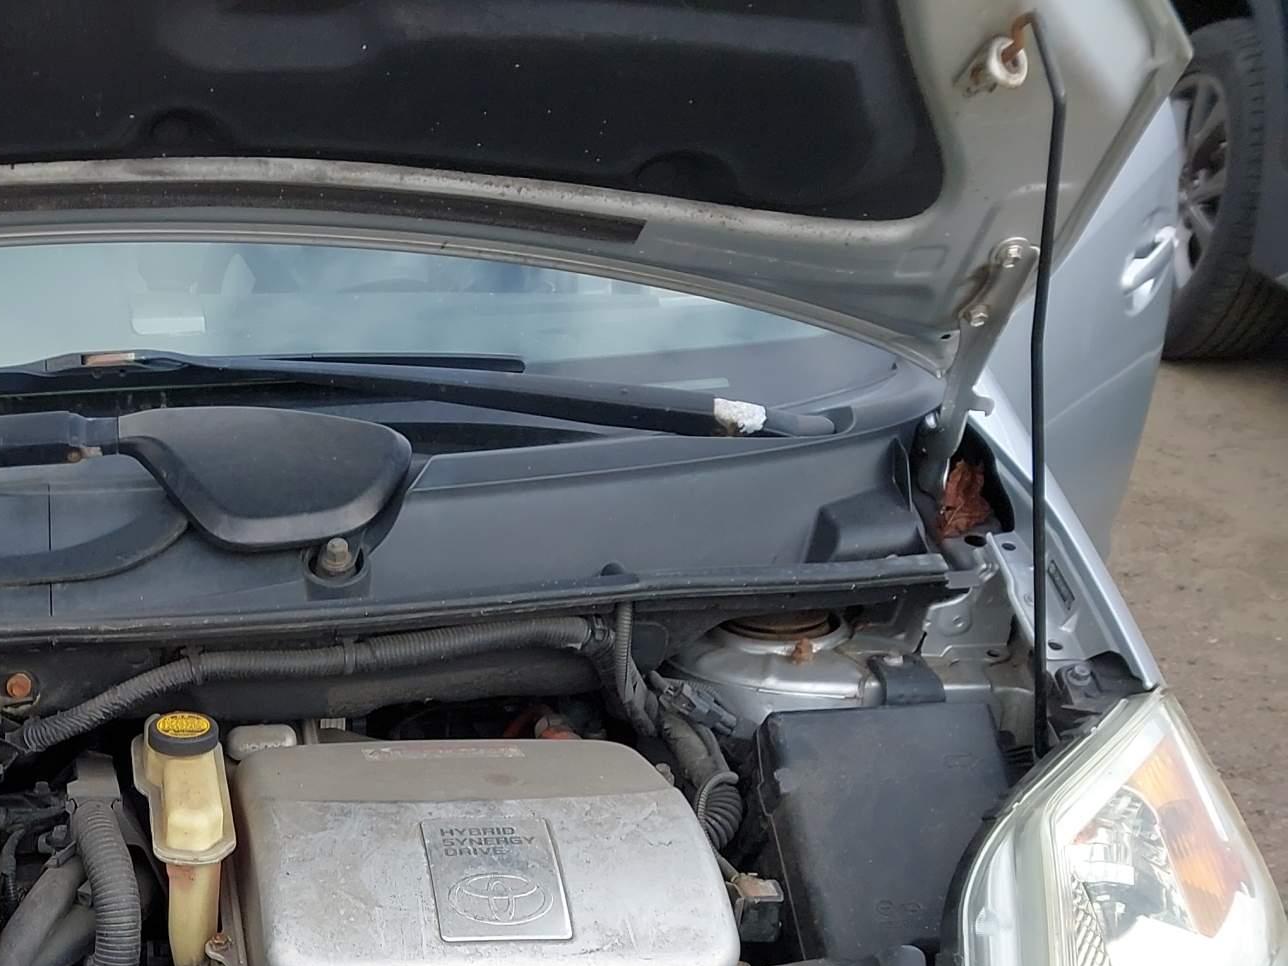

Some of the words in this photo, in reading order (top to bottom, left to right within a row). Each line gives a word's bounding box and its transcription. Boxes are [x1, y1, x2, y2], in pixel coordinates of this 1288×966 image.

[440, 827, 515, 837] HYBRID
[442, 836, 535, 847] SYNERGY
[444, 846, 509, 857] DRIVE
